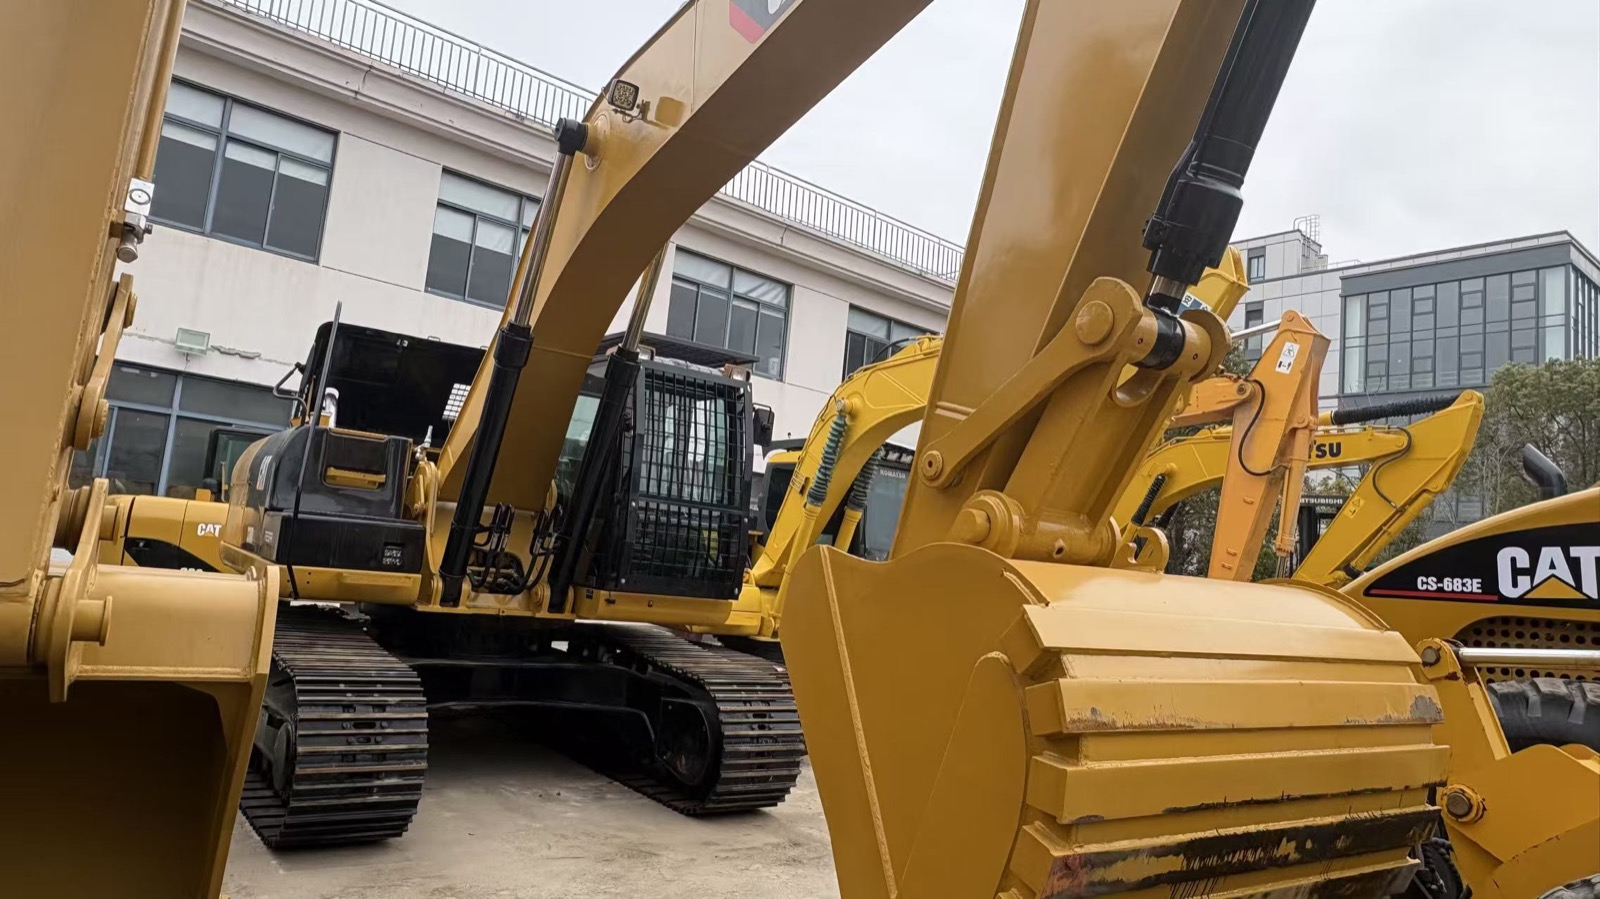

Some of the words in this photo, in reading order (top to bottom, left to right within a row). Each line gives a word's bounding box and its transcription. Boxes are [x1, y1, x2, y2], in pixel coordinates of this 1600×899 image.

[880, 469, 906, 479] KOMATSU
[197, 523, 222, 538] CAT
[1497, 546, 1600, 599] CAT
[1417, 576, 1482, 593] CS-683E
